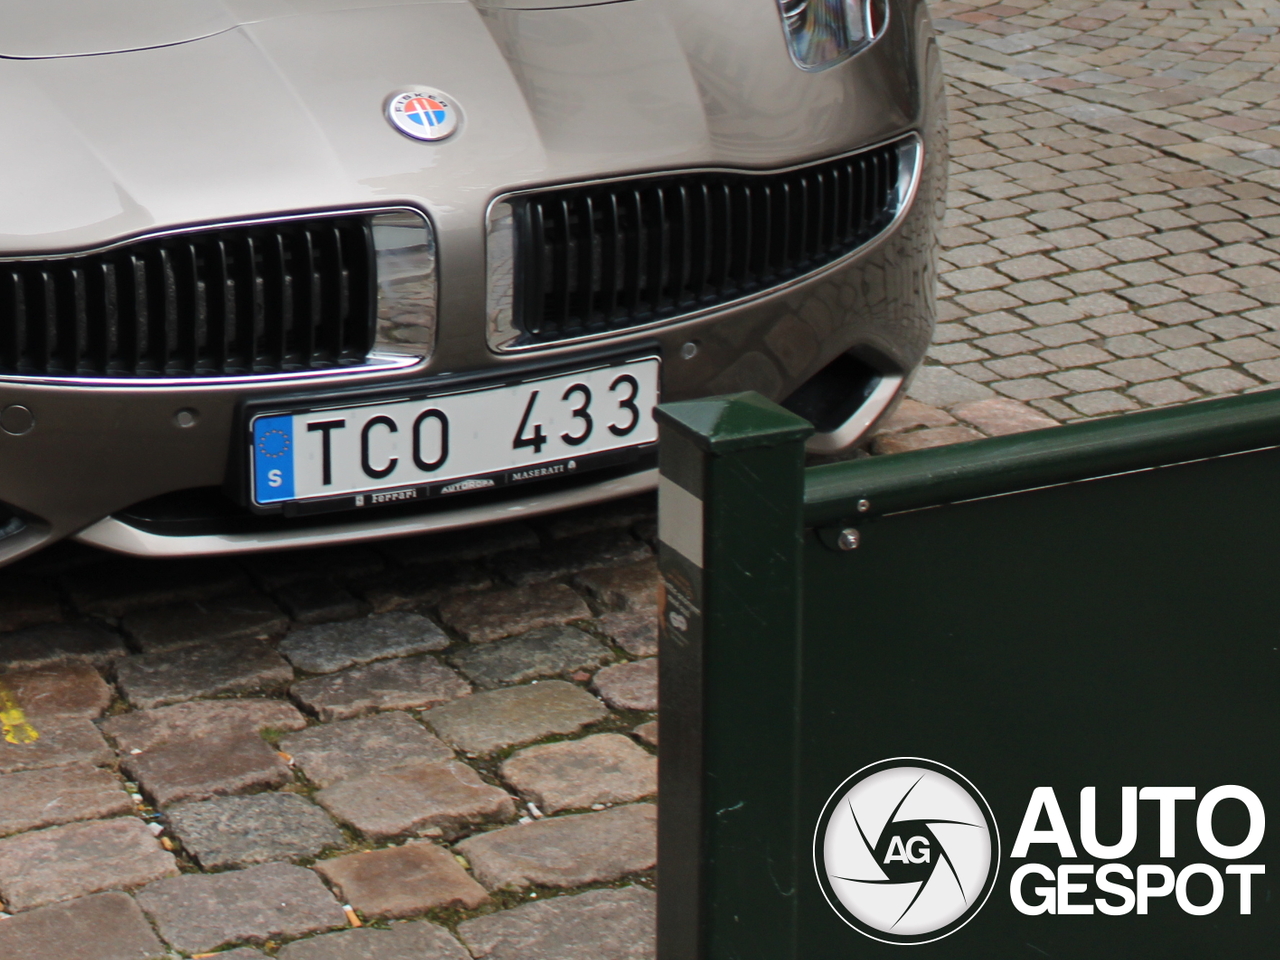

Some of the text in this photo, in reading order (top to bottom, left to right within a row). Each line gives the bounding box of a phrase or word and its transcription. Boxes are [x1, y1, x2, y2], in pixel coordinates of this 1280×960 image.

[306, 374, 640, 486] TCO 433
[267, 469, 283, 488] S
[512, 464, 565, 481] MASERATI
[371, 488, 418, 504] Ferrari
